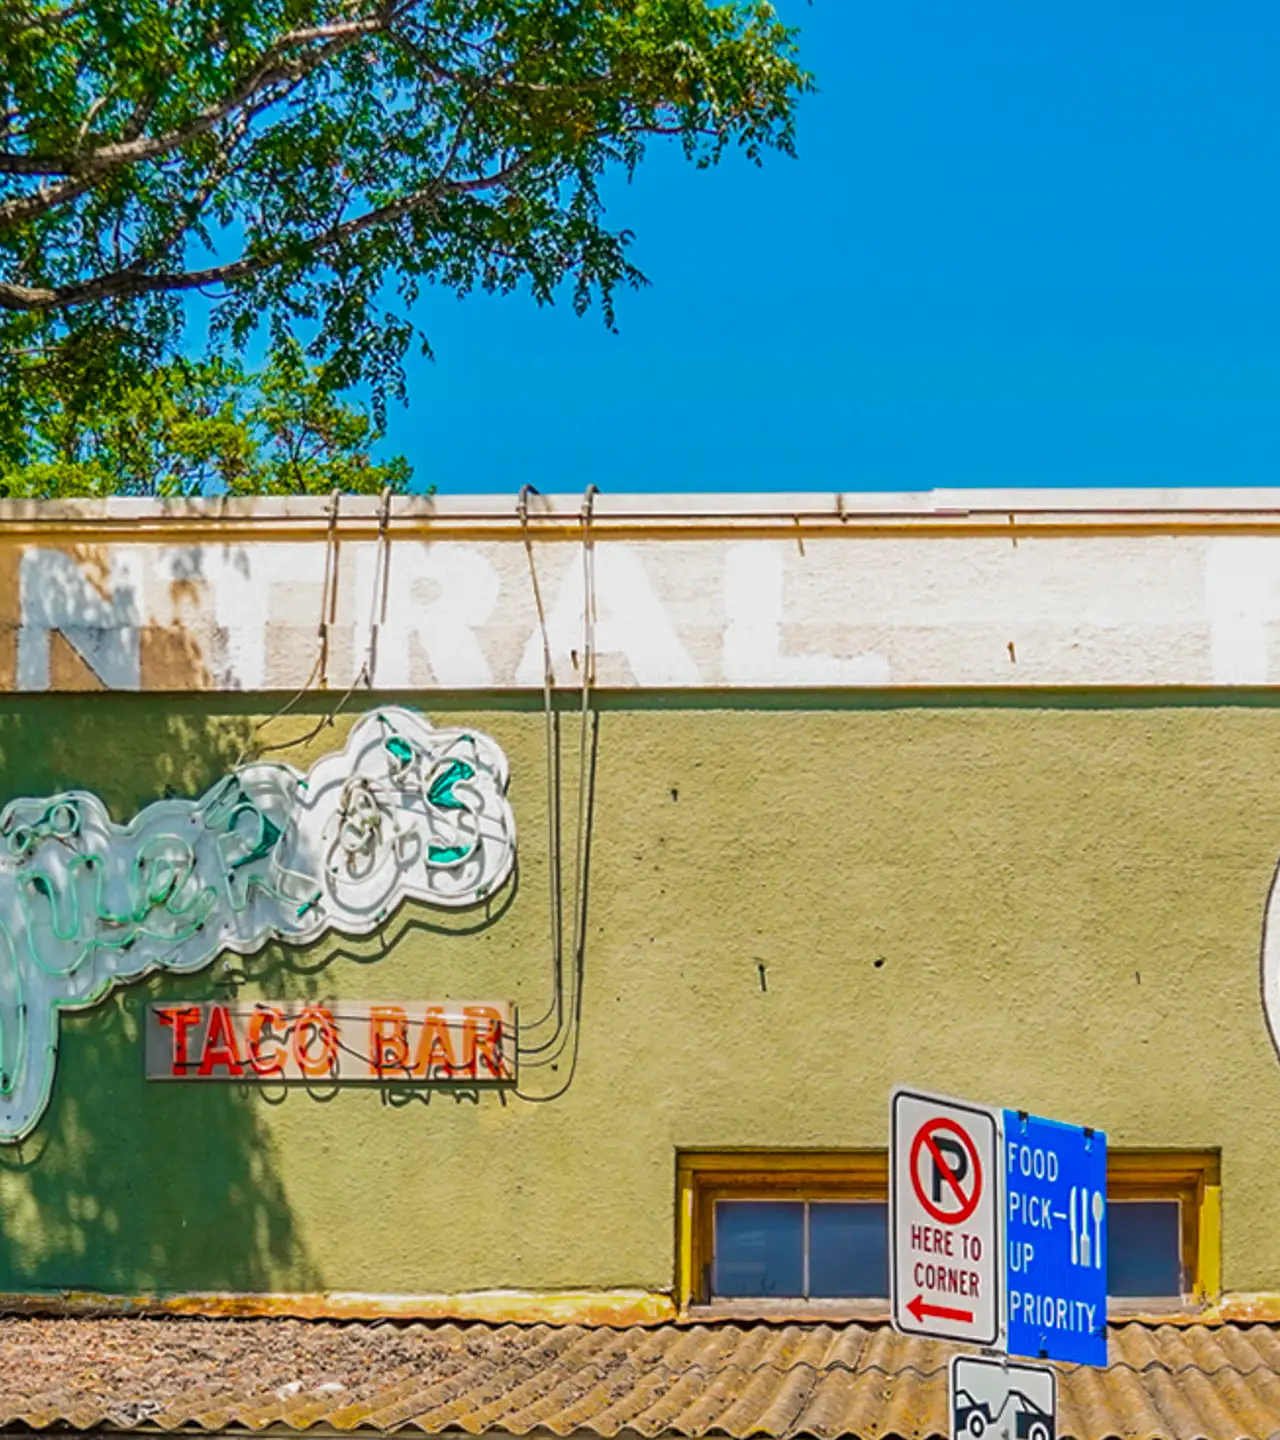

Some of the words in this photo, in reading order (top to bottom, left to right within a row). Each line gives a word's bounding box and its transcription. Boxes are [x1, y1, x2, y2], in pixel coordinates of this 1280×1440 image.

[159, 1004, 336, 1078] TACO
[368, 1004, 507, 1079] BAR
[1008, 1141, 1059, 1183] FOOD
[1009, 1195, 1068, 1231] PICK-
[911, 1224, 954, 1257] HERE
[961, 1233, 982, 1262] TO
[1009, 1241, 1033, 1273] UP
[914, 1261, 980, 1298] CORNER
[1009, 1290, 1097, 1336] PRIORITY
